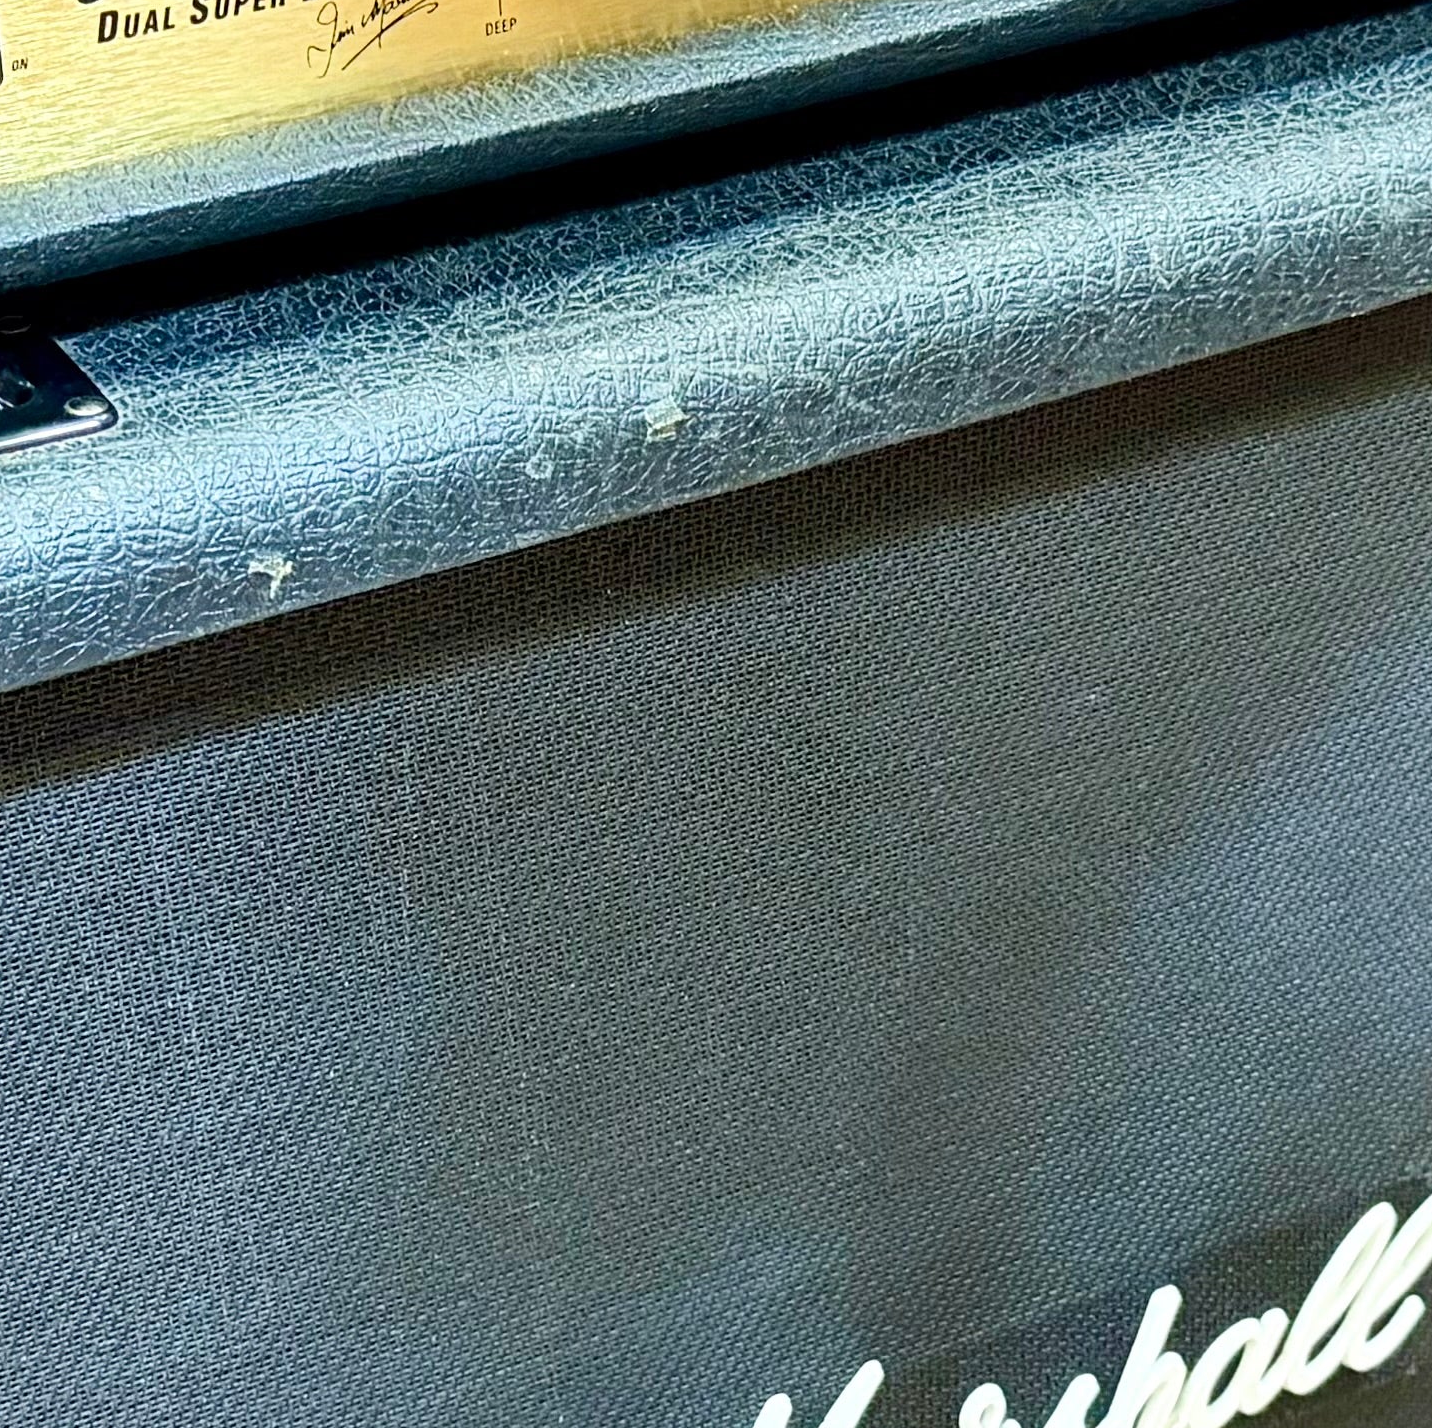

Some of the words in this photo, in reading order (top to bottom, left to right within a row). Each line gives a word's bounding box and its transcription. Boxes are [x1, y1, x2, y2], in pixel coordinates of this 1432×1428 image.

[97, 6, 176, 44] DUAL
[485, 17, 517, 37] DEEP
[11, 57, 30, 72] ON
